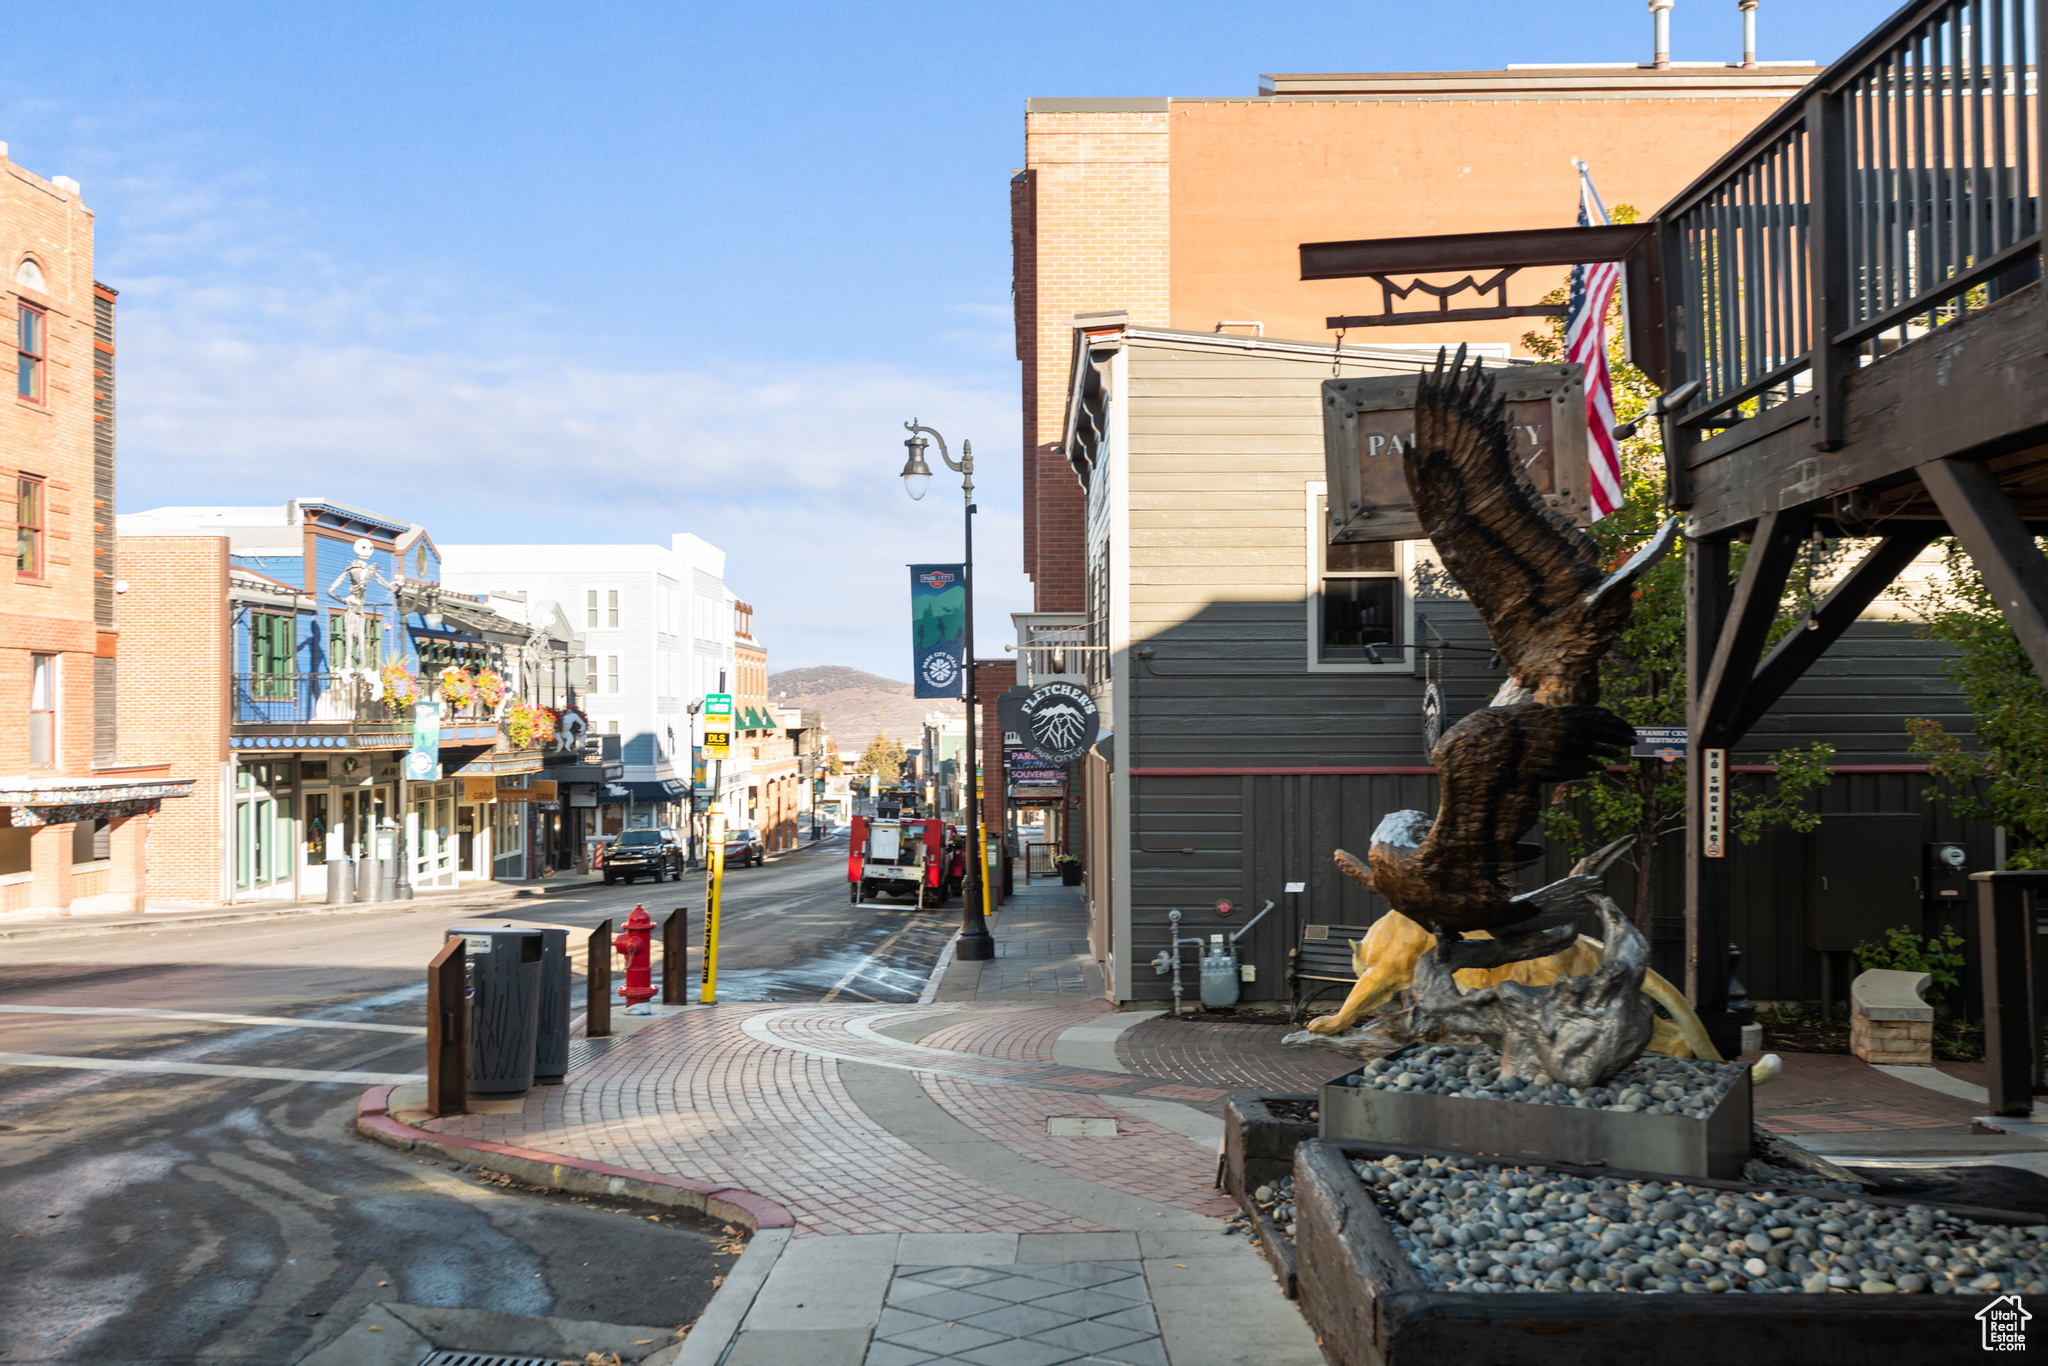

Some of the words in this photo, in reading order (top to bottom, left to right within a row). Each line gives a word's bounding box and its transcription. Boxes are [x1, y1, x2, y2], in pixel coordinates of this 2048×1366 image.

[922, 654, 934, 669] PARK
[946, 654, 958, 669] UTAH
[1021, 684, 1097, 715] FLETCHER'S
[707, 733, 727, 743] DLS
[1032, 746, 1055, 762] PARK
[1054, 752, 1075, 763] CITY
[1074, 745, 1086, 758] UT
[1710, 751, 1719, 769] NO
[1011, 770, 1055, 778] SOUVENIR
[473, 790, 494, 800] cake
[1709, 775, 1720, 842] SMOKING
